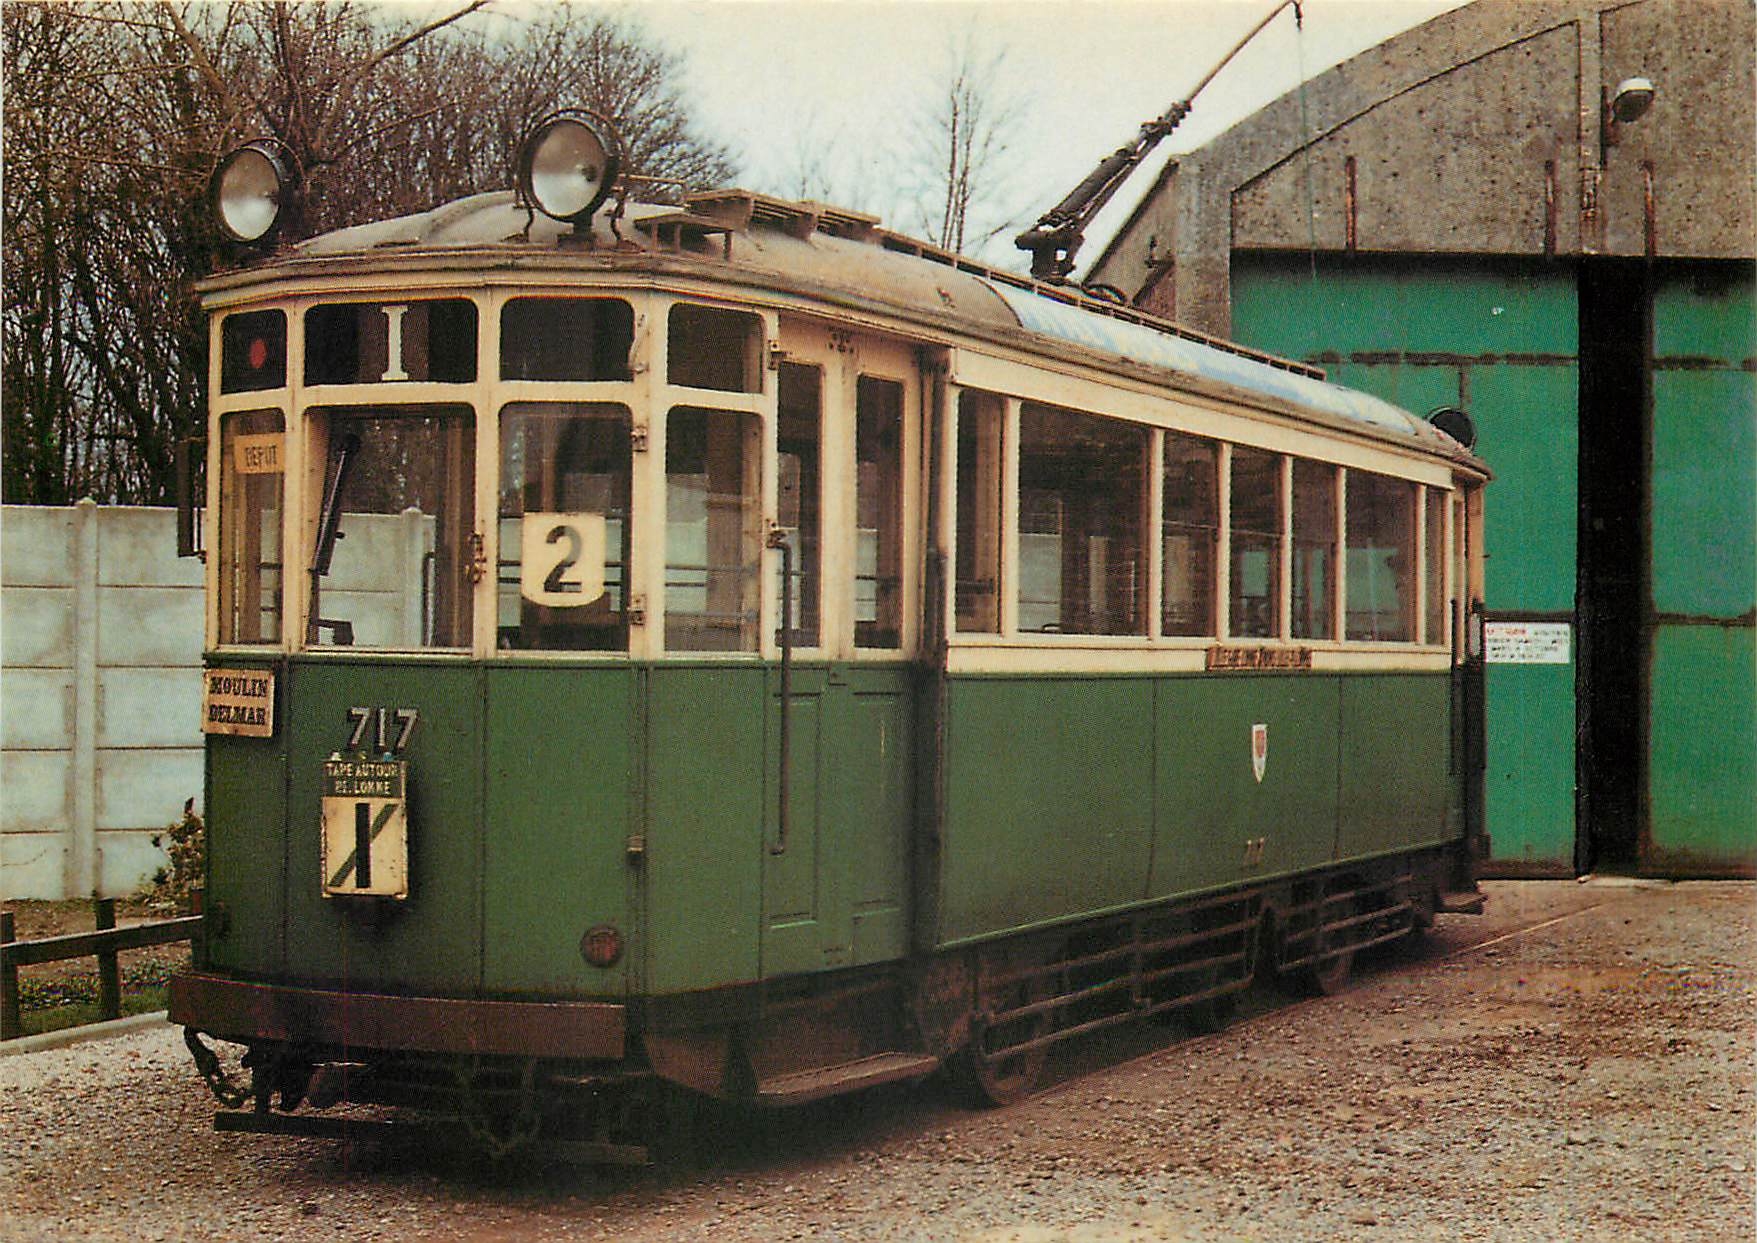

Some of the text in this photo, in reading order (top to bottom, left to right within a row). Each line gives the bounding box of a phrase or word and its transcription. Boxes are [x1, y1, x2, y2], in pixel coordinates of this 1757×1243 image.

[543, 525, 583, 594] 2
[209, 676, 268, 698] MOULIN
[208, 704, 266, 726] DELMAR
[348, 706, 419, 750] 717
[326, 762, 353, 777] TAPE
